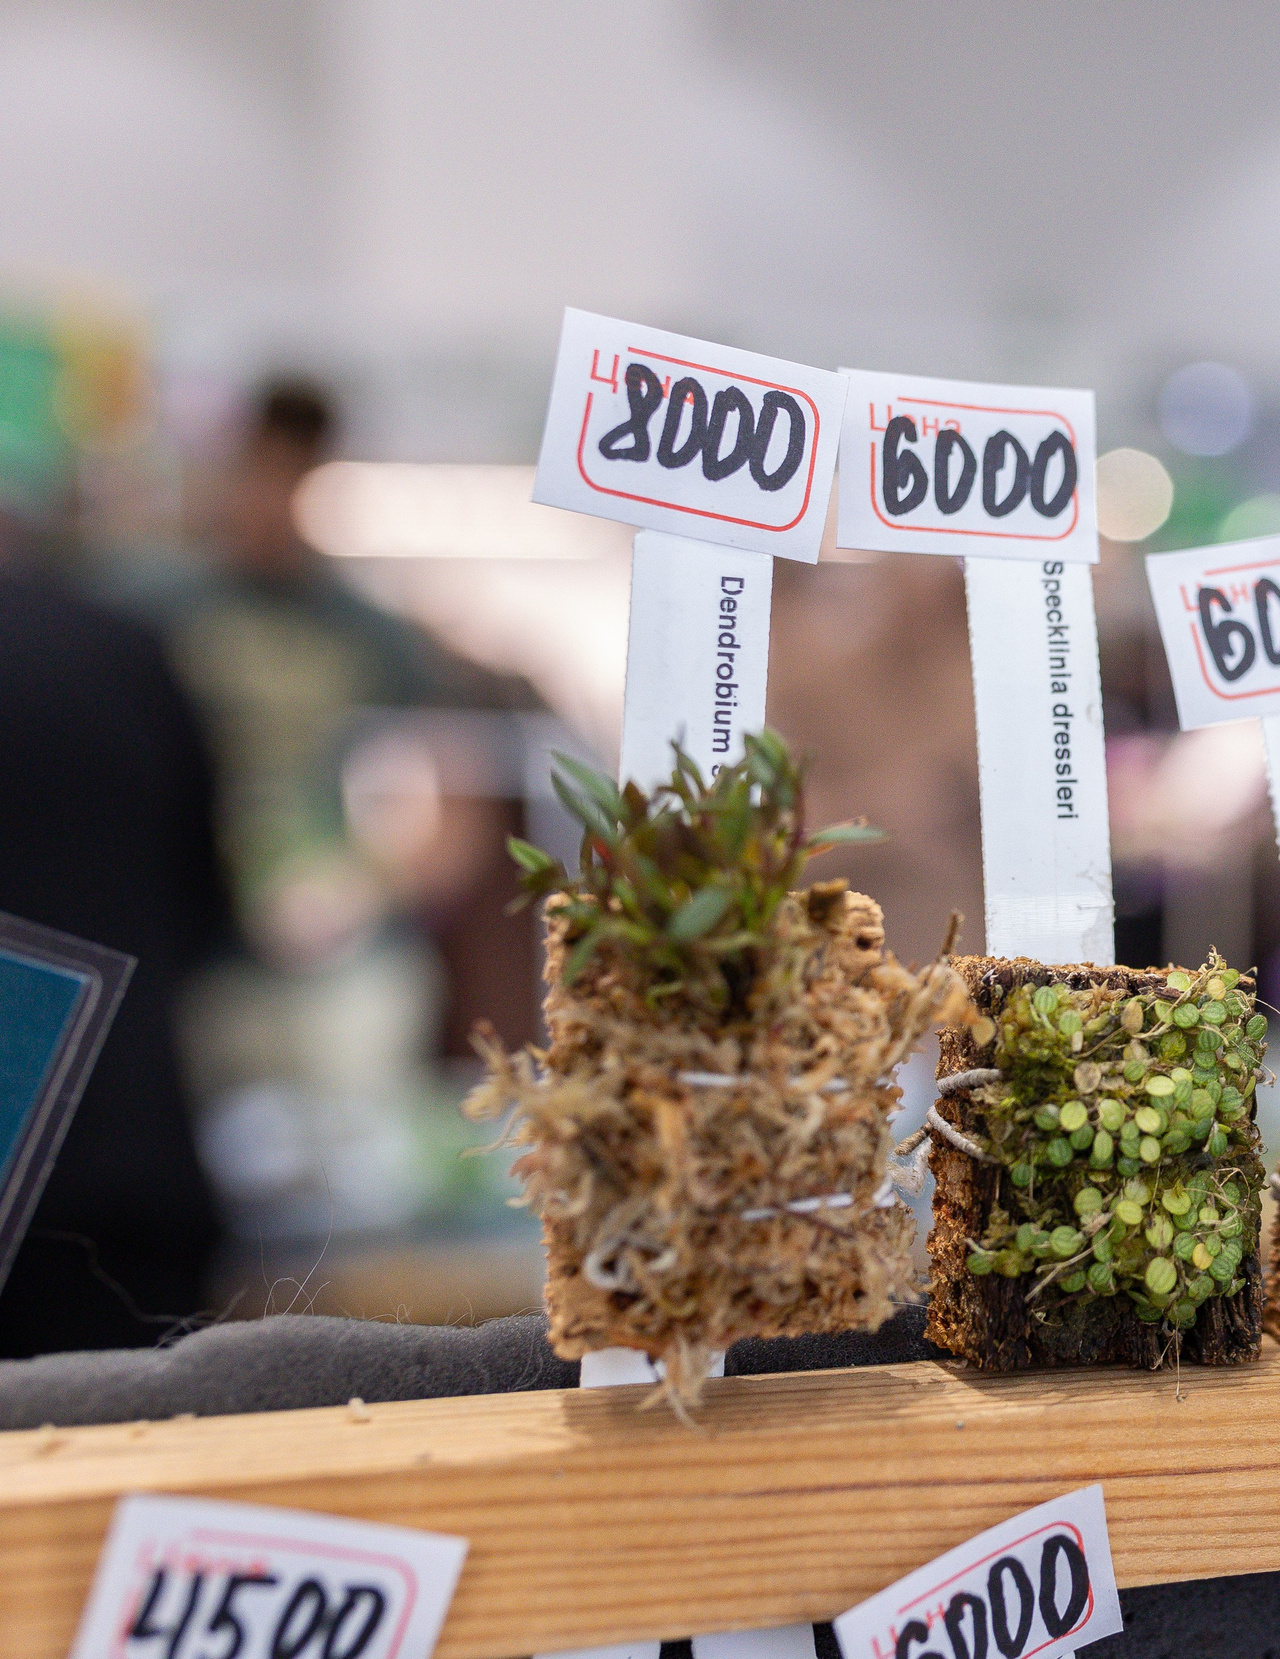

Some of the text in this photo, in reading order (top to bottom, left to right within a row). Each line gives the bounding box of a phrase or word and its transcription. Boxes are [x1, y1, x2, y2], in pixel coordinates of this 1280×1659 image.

[598, 363, 806, 491] 8000
[882, 415, 1078, 519] 6000
[711, 576, 745, 753] Dendrobium
[1042, 561, 1079, 819] Specklinia dressleri
[125, 1565, 388, 1659] 4500
